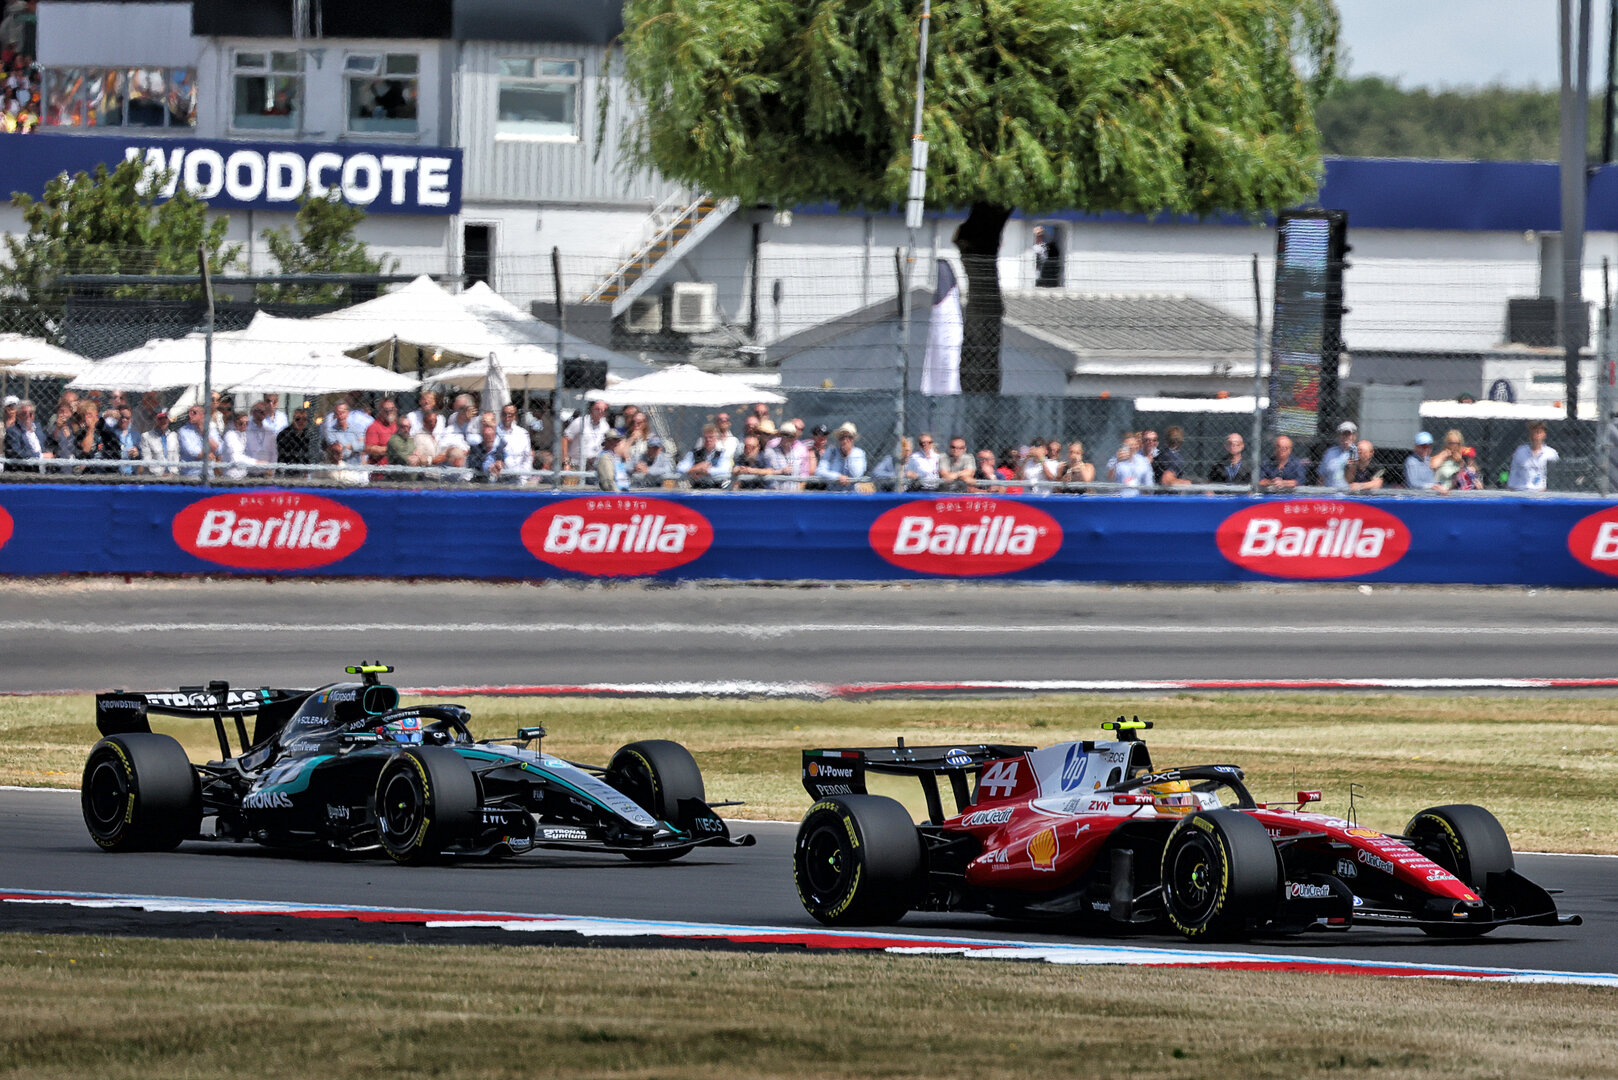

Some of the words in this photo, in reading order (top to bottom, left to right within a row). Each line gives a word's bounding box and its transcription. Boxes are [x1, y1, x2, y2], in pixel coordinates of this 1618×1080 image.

[125, 147, 452, 206] WOODCOTE
[196, 509, 342, 550] Barilla
[543, 514, 687, 554] Barilla
[892, 515, 1039, 556] Barilla
[1238, 517, 1387, 559] Barilla
[328, 690, 357, 702] Microsoft
[102, 700, 142, 710] CROWDSTRIKE
[818, 764, 853, 777] V-Power
[1062, 741, 1088, 793] hp
[980, 761, 1019, 797] 44
[1142, 771, 1180, 784] DXC
[815, 783, 853, 796] PERONI
[1088, 800, 1112, 812] ZYN
[1134, 795, 1154, 804] ZYN
[971, 807, 1015, 824] UniCredit
[695, 818, 723, 832] INEOS
[543, 828, 587, 836] PETRONAS
[544, 832, 588, 840] Syntium
[509, 836, 531, 847] Microsoft
[1338, 861, 1357, 876] FIA
[1366, 852, 1395, 876] UniCredit
[1299, 884, 1331, 897] UniCredit
